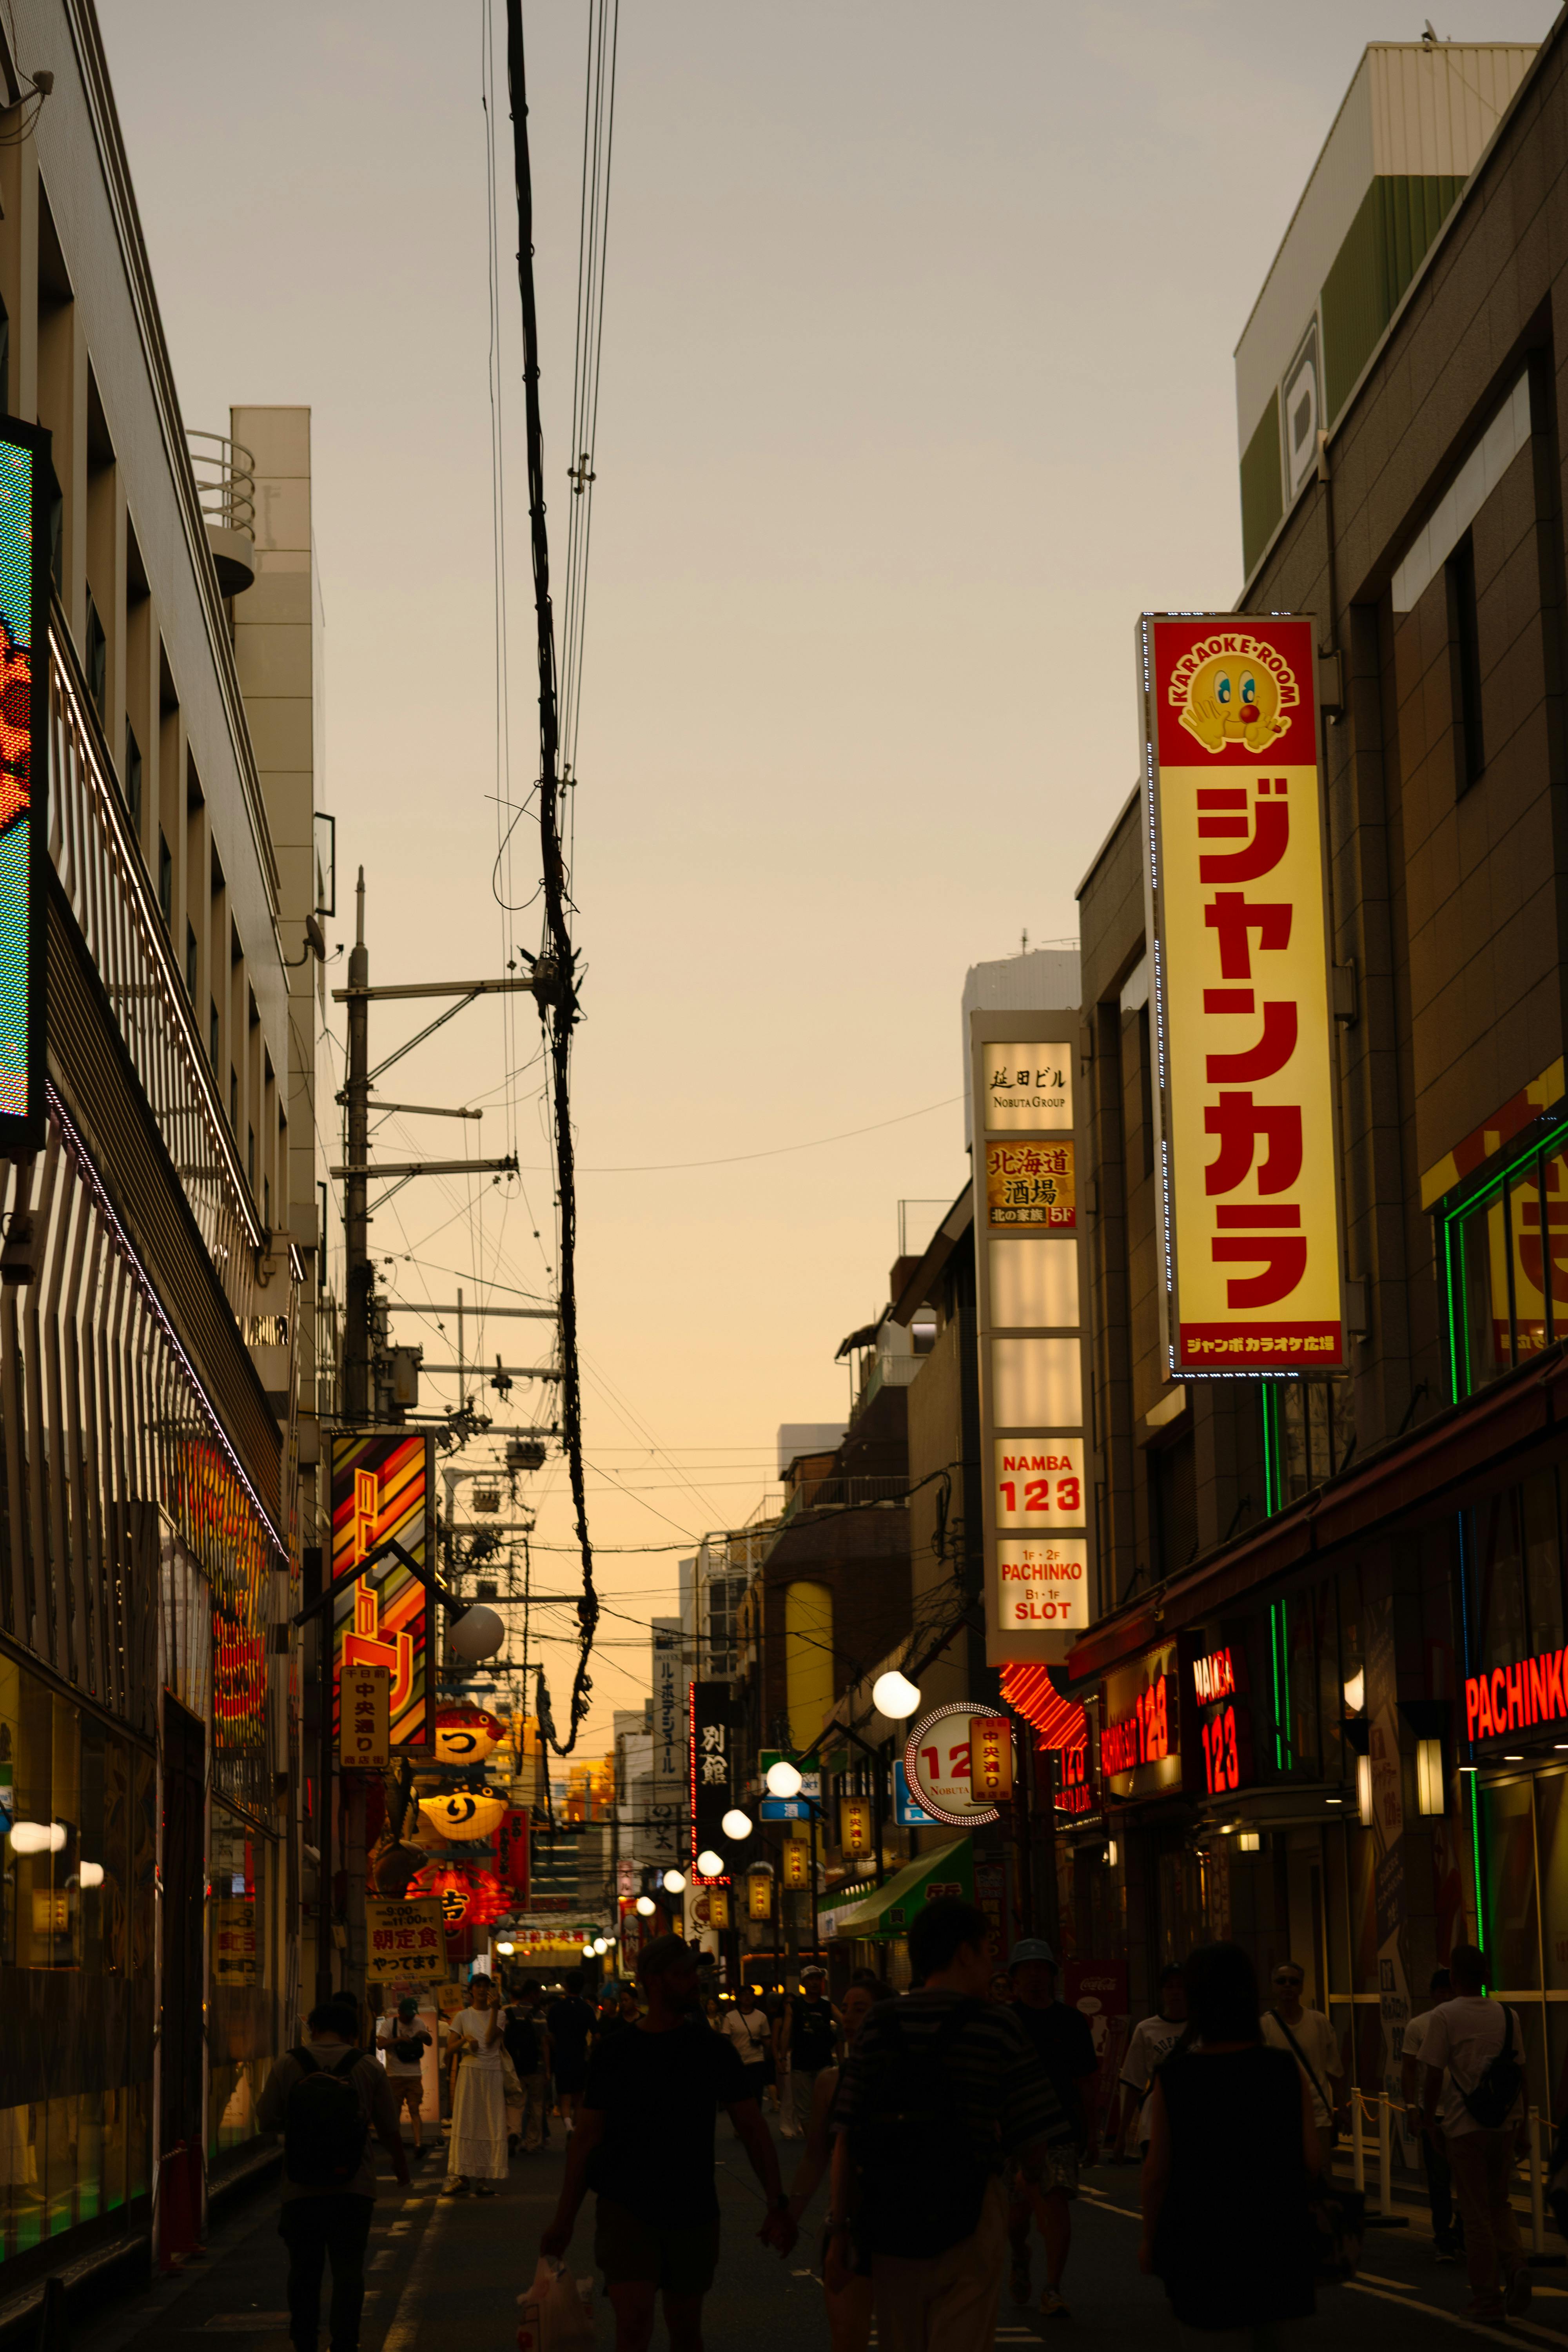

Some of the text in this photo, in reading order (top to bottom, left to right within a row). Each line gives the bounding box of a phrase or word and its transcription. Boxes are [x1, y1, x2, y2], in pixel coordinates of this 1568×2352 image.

[1197, 778, 1307, 1309] ジャンカラ
[990, 1067, 1066, 1089] 延田ビル
[989, 1149, 1071, 1176] 北海道
[1005, 1179, 1057, 1205] 酒場
[991, 1207, 1073, 1222] 北の家族 5F
[1187, 1335, 1334, 1353] ジャンボカラオケ広場
[1004, 1456, 1072, 1471] NAMBA
[1000, 1477, 1080, 1512] 123
[1002, 1563, 1082, 1581] PACHINKO
[1015, 1602, 1071, 1619] SLOT
[346, 1669, 385, 1678] 千日前
[1465, 1643, 1568, 1742] PACHINK
[354, 1682, 375, 1751] 中央通り
[345, 1756, 384, 1764] 商店街
[699, 1723, 728, 1786] 別館
[983, 1731, 999, 1788] 中央通り
[1202, 1705, 1239, 1794] 123
[373, 1926, 438, 1951] 朝定食
[373, 1954, 439, 1971] やってます
